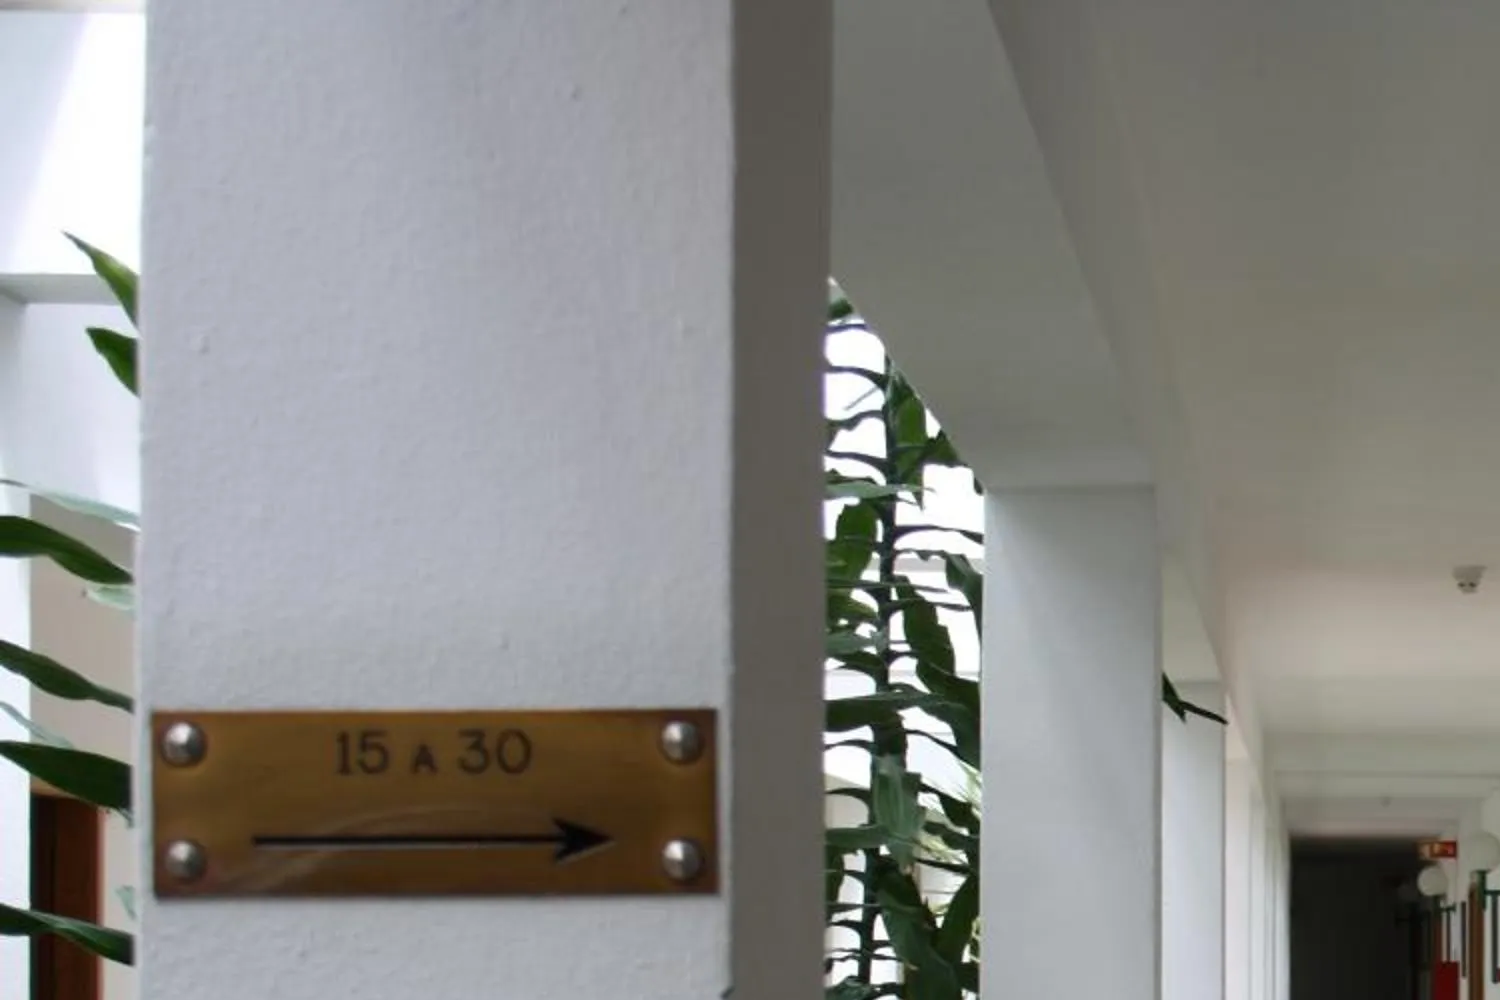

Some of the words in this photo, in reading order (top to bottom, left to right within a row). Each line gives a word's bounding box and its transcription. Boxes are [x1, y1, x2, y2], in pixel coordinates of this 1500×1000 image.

[336, 730, 390, 775] 15
[410, 742, 439, 774] A
[457, 728, 532, 775] 30
